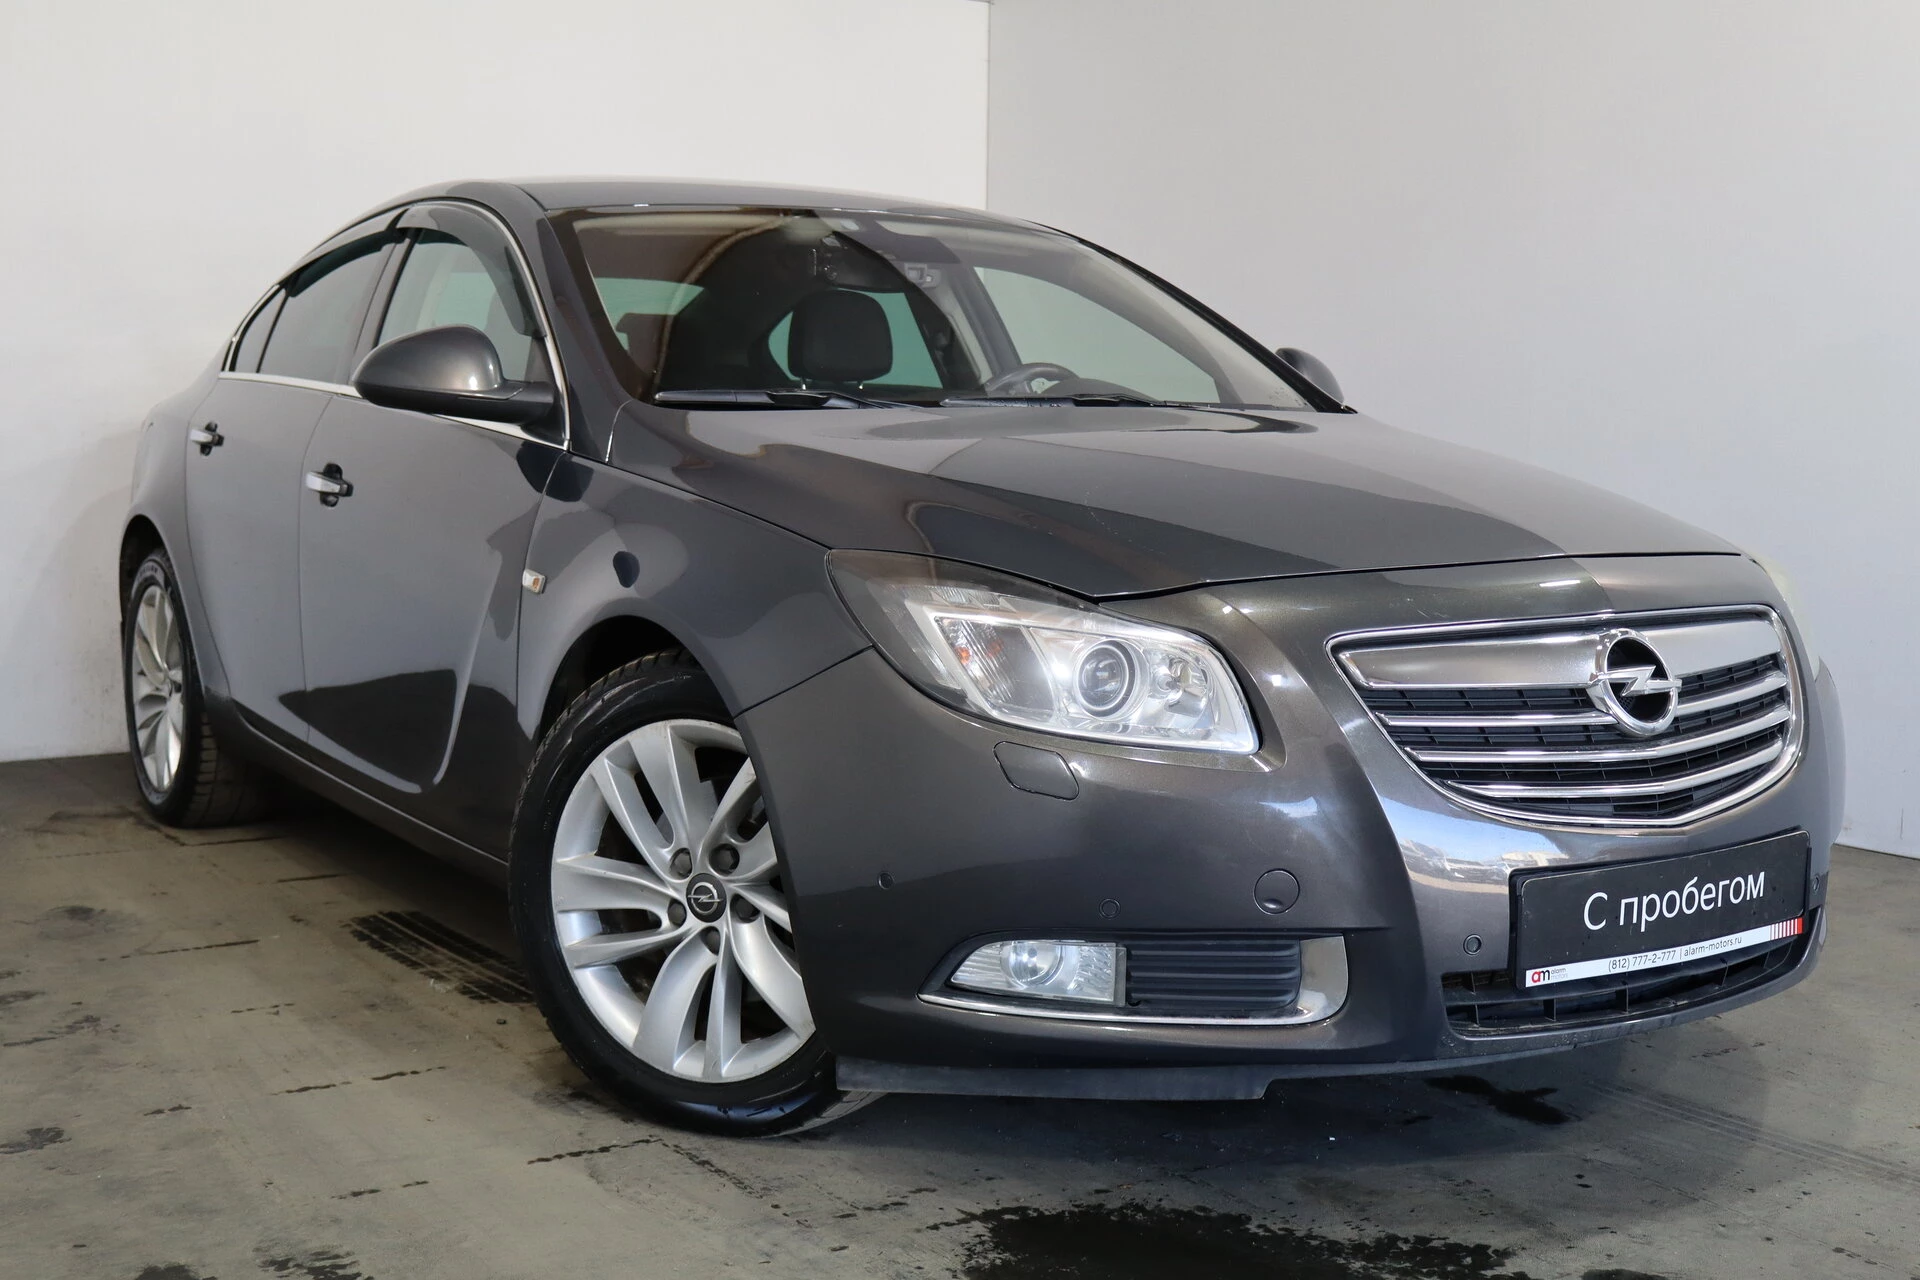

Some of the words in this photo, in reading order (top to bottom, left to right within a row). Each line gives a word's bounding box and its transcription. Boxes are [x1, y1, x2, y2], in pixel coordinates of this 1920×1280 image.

[1583, 892, 1607, 930] С
[1619, 871, 1765, 932] пробегом
[1684, 937, 1742, 957] alarm-motors.ru
[1608, 958, 1630, 972] (812)
[1632, 950, 1677, 966] 777-2-777
